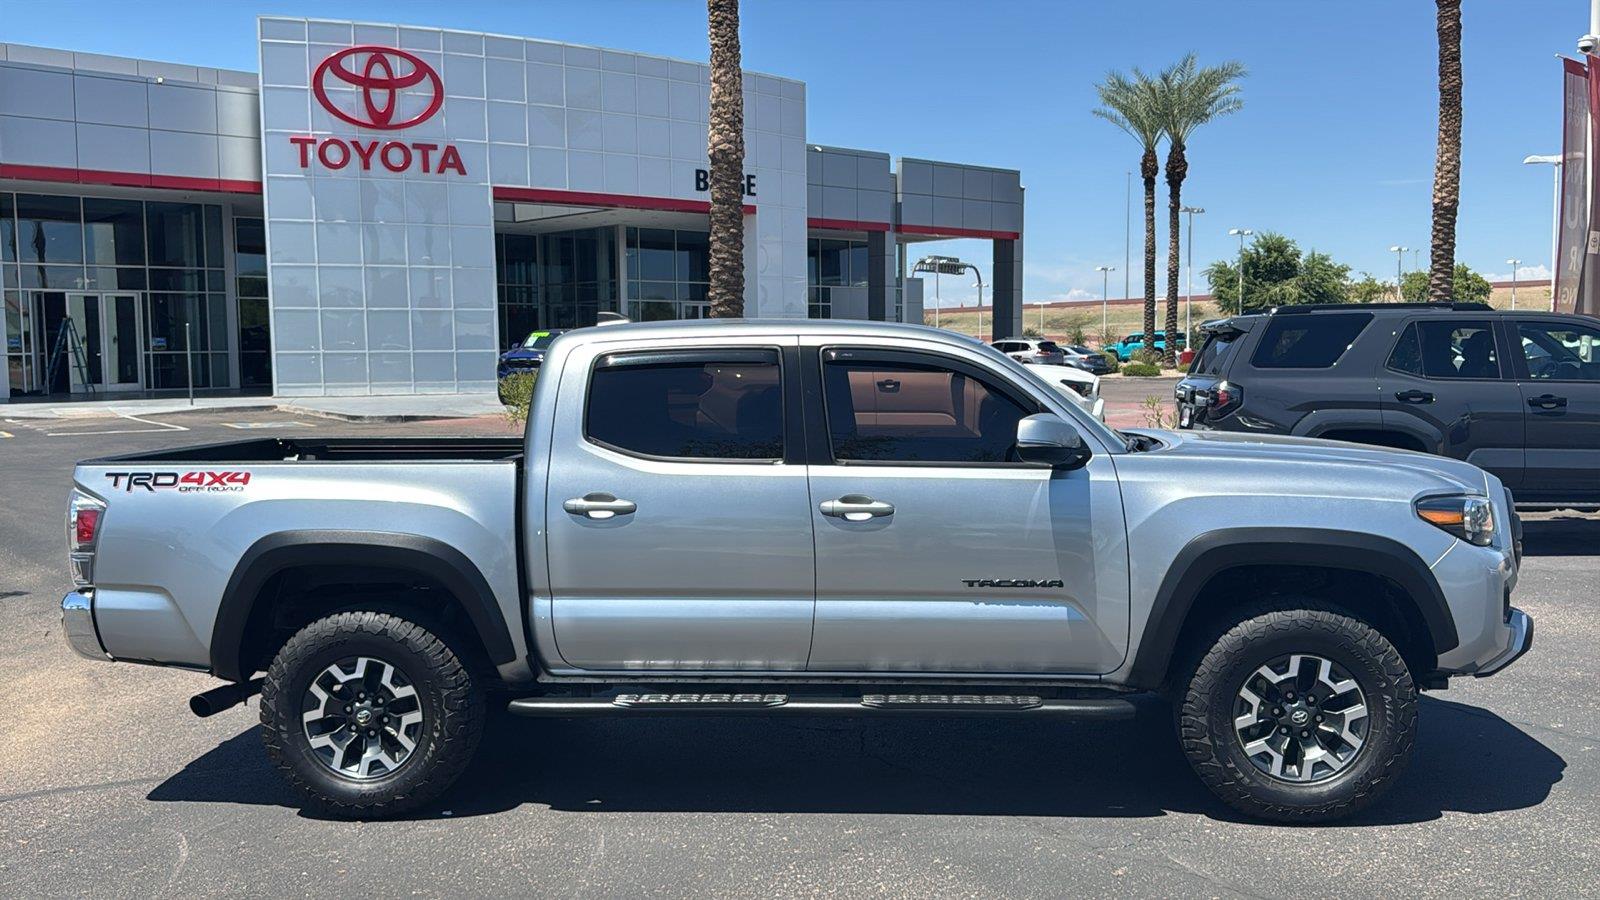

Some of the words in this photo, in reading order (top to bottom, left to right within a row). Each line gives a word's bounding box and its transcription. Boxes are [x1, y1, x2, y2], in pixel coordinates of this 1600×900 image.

[290, 137, 467, 176] TOYOTA
[105, 472, 179, 492] TRD
[180, 471, 251, 486] 4X4
[961, 579, 1064, 588] TACOMA
